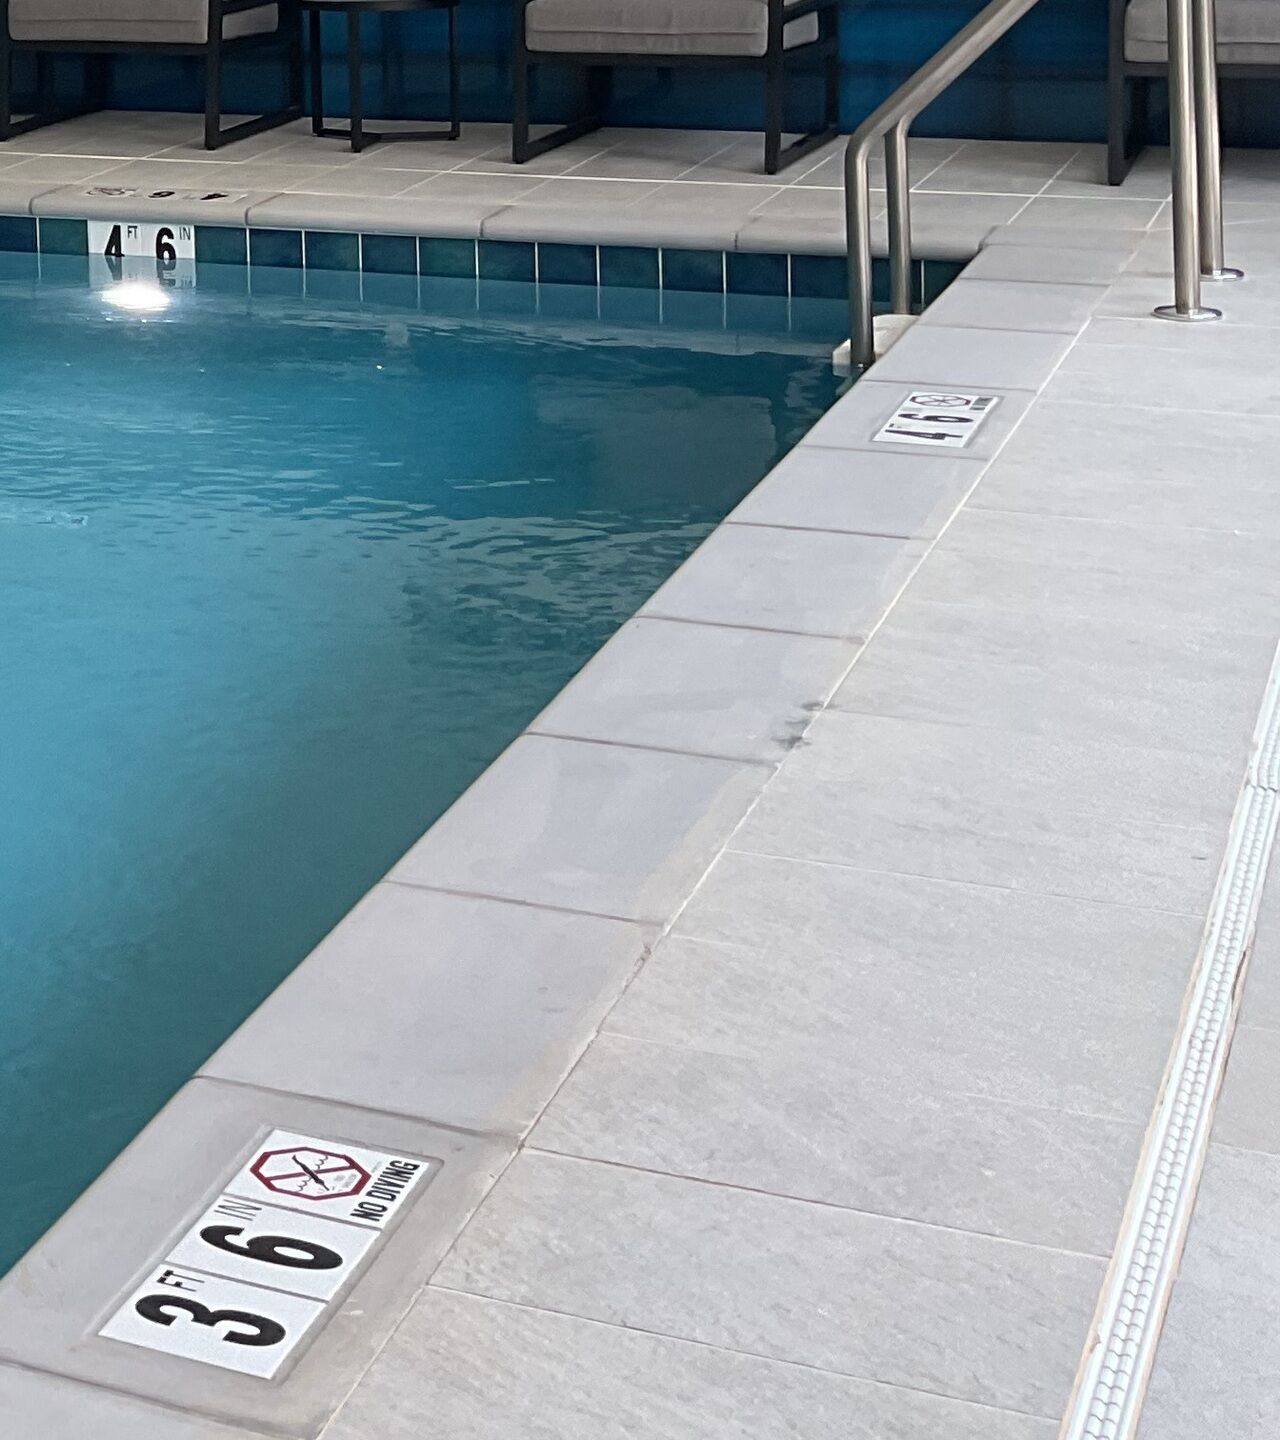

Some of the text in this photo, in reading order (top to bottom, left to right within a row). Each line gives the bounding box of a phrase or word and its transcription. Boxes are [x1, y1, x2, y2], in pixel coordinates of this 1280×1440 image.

[104, 224, 191, 261] 4 FT 6 IN
[350, 1159, 421, 1222] NO DIVING
[135, 1198, 344, 1347] 3 FT 6 IN
